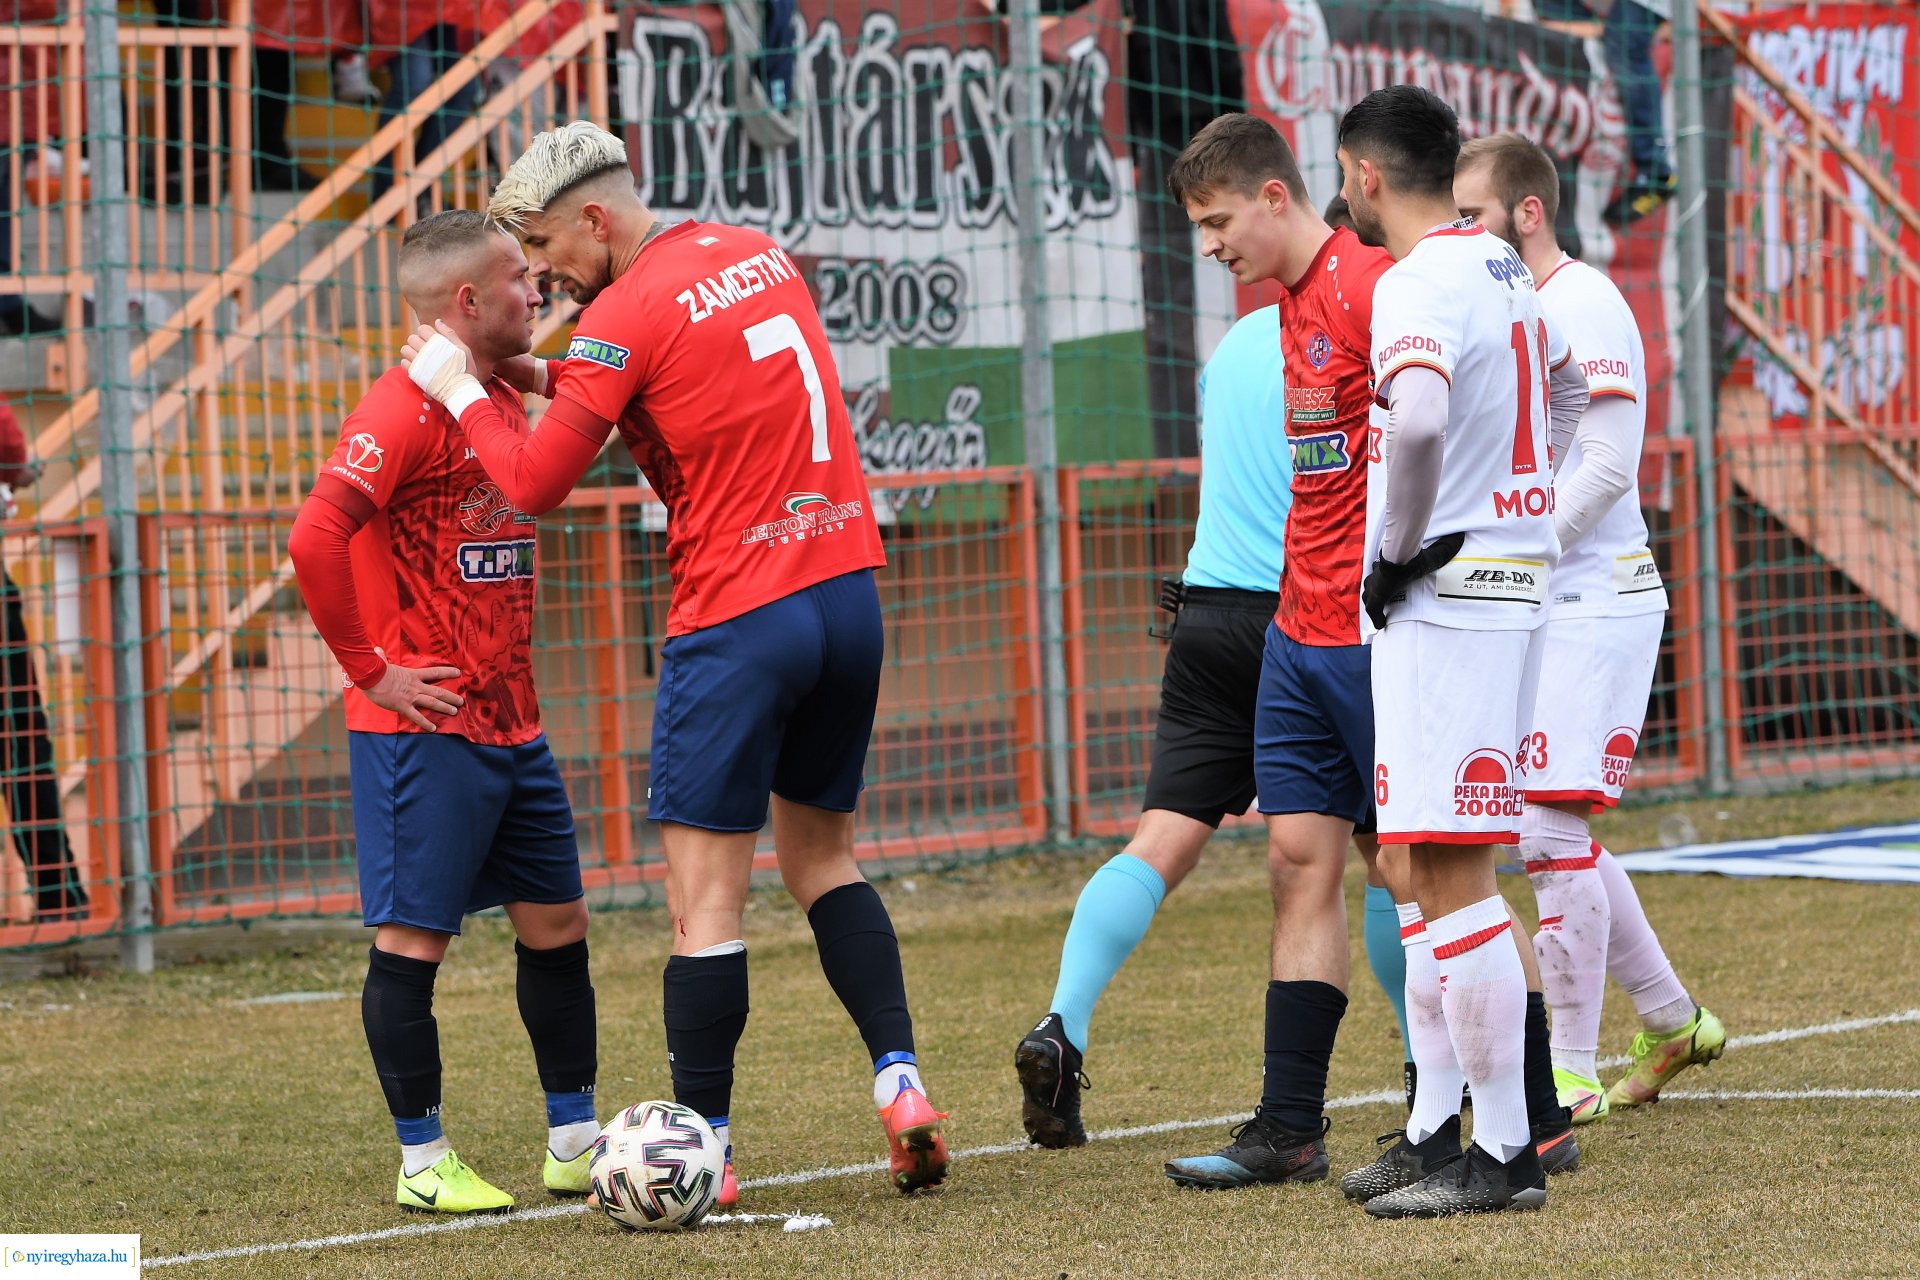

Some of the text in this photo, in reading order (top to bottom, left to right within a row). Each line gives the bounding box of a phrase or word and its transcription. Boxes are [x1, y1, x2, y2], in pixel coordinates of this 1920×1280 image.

[1486, 245, 1529, 291] apoll
[675, 247, 798, 324] ZAMOSTNY
[816, 258, 969, 345] 2008
[566, 339, 625, 367] PPMIX
[1378, 335, 1442, 370] BORSODI
[1577, 358, 1629, 379] ORSODI
[742, 313, 832, 463] 7
[464, 447, 478, 459] JA
[768, 521, 845, 547] HUNGARY
[1454, 784, 1489, 799] PEKA
